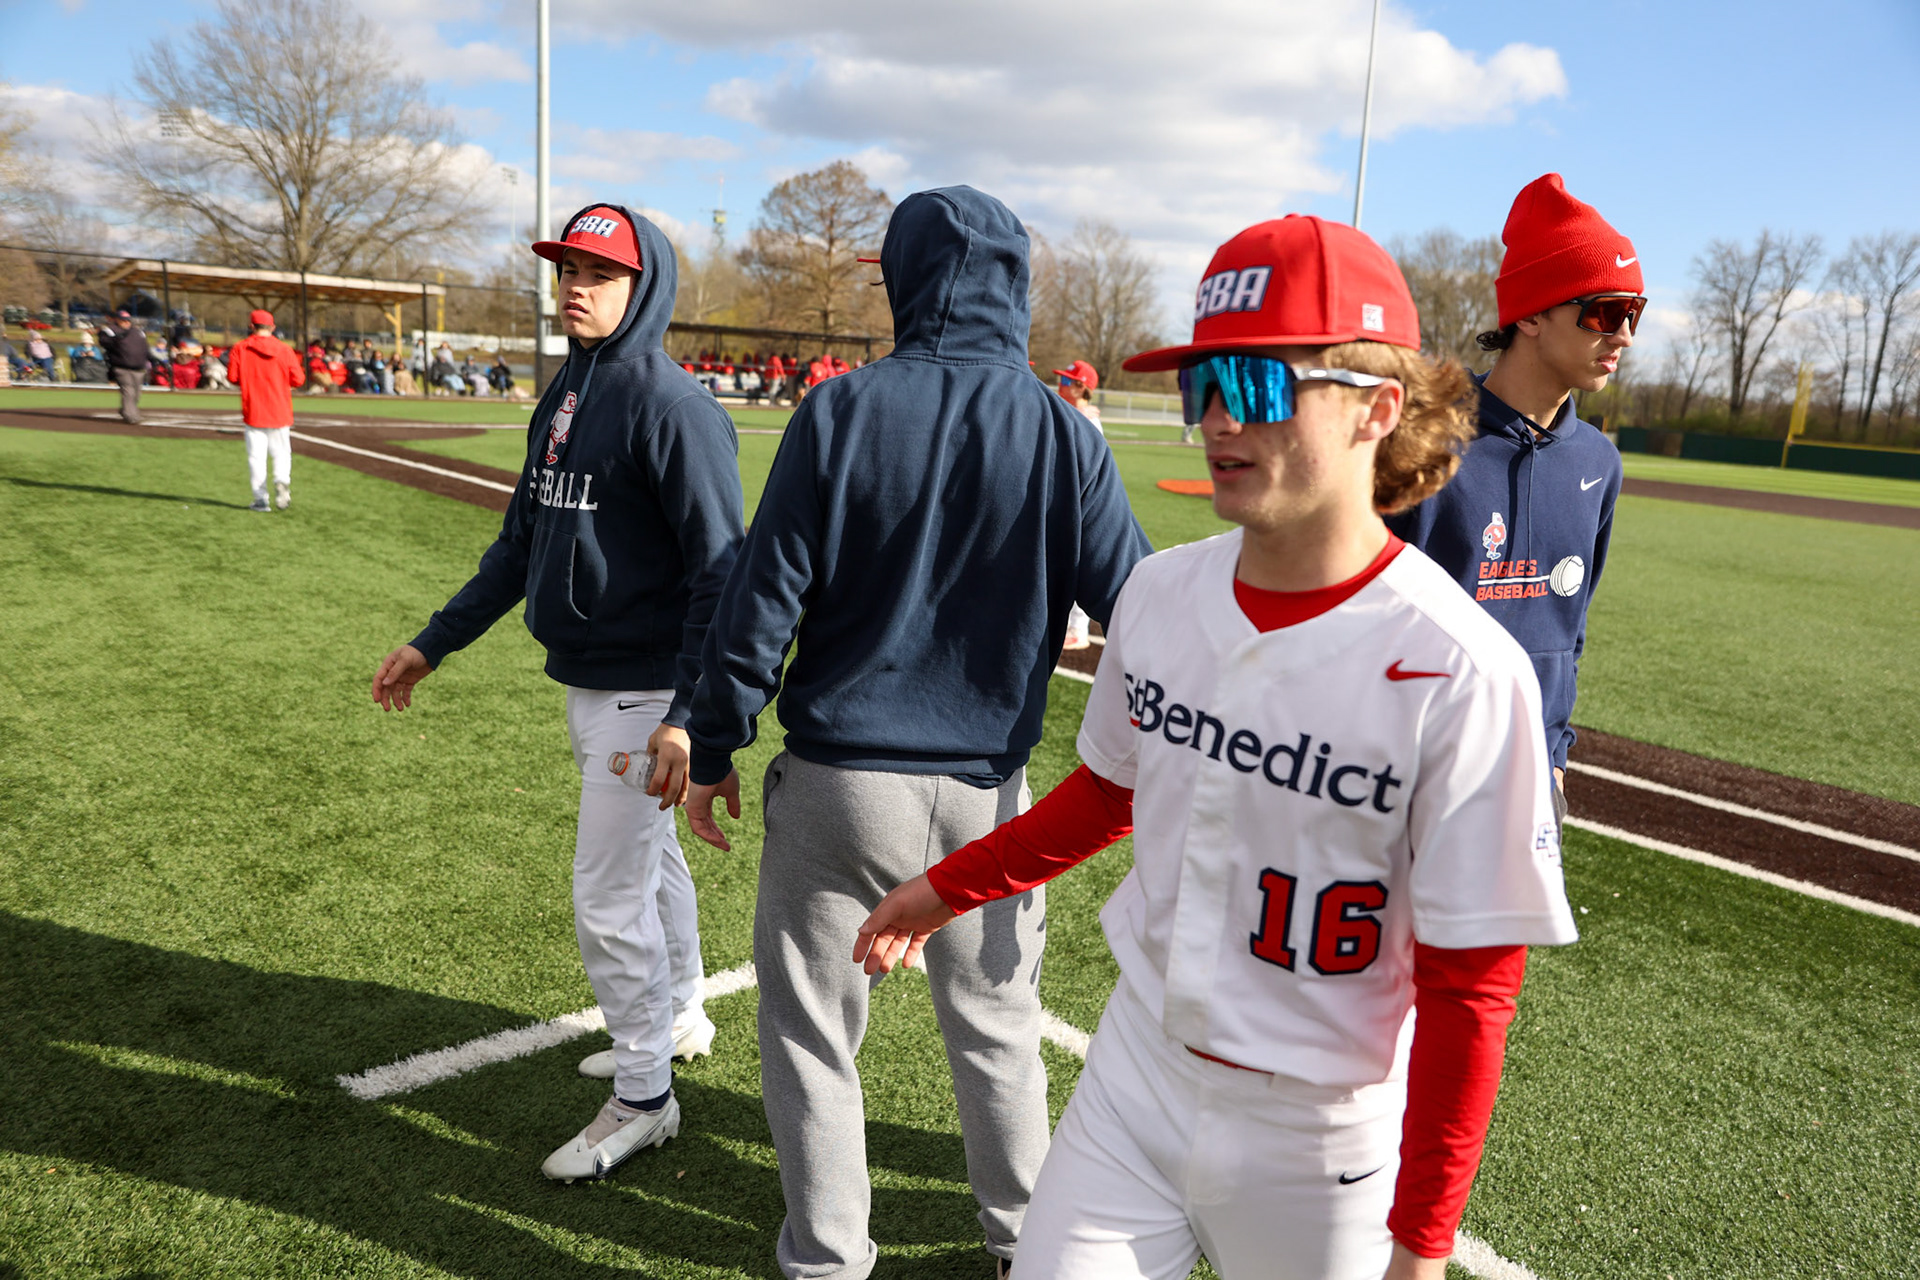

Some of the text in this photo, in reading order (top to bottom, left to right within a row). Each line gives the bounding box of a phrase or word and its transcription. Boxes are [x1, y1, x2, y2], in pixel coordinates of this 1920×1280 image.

[570, 215, 620, 239] SBA
[1195, 265, 1274, 323] SBA
[1475, 581, 1549, 602] BASEBALL
[1249, 867, 1389, 976] 16
